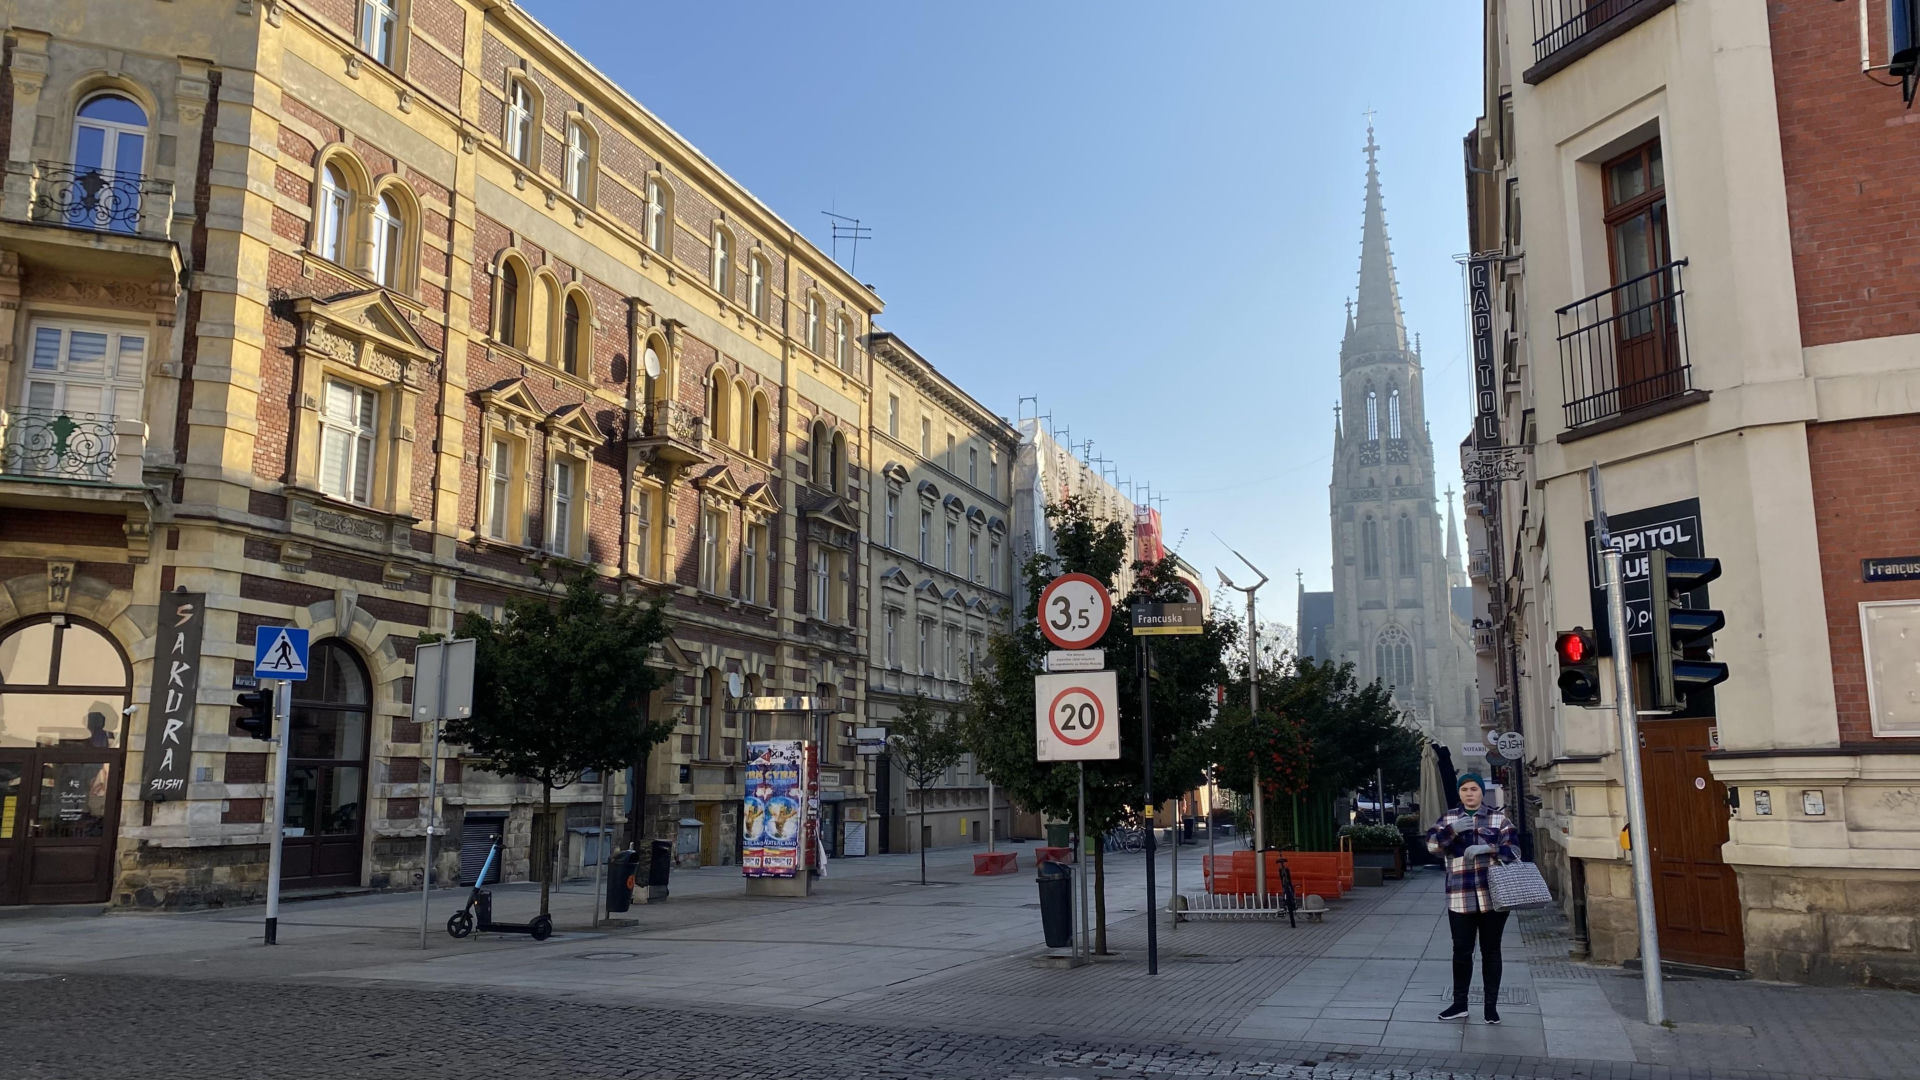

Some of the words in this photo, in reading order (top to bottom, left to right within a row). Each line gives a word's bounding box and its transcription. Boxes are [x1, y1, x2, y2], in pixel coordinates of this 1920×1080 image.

[1472, 265, 1497, 439] CAPITOL
[1609, 524, 1692, 553] APITOL
[1050, 595, 1090, 632] 3,5
[1089, 594, 1095, 605] t
[1138, 613, 1183, 624] Francuska
[159, 603, 195, 772] SAKURA
[1061, 702, 1096, 731] 20
[1499, 739, 1525, 750] SUSHI
[150, 778, 184, 791] SUSHI
